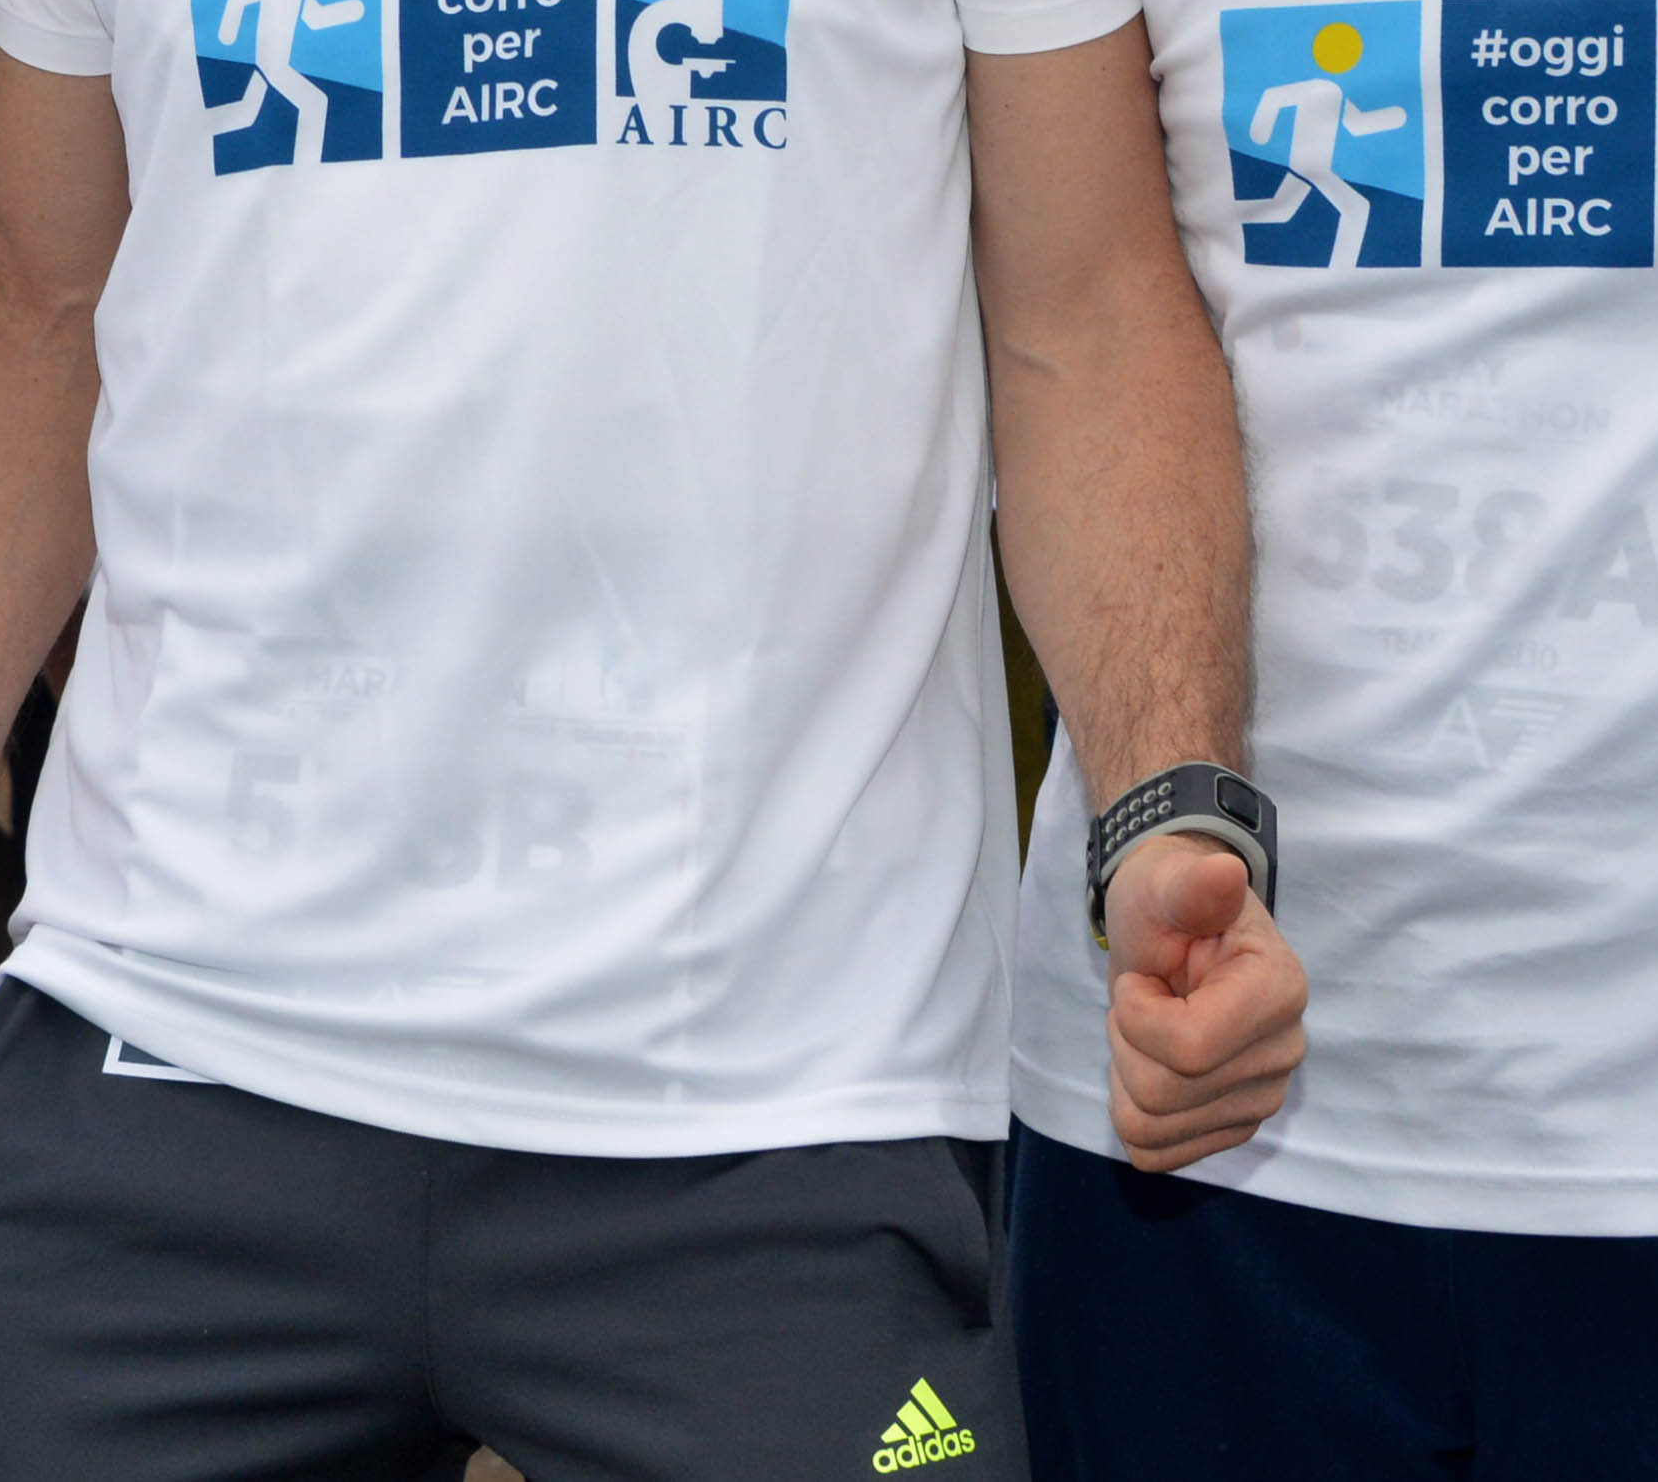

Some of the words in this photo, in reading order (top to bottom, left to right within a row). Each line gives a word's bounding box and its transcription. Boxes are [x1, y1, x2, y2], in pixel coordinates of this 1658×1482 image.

[463, 27, 541, 73] per
[1471, 24, 1624, 77] #oggi
[442, 78, 558, 125] AIRC
[1482, 92, 1618, 126] corro
[616, 105, 787, 150] AIRC
[1508, 142, 1594, 183] per
[1485, 198, 1612, 236] AIRC
[872, 1428, 976, 1474] adidas
